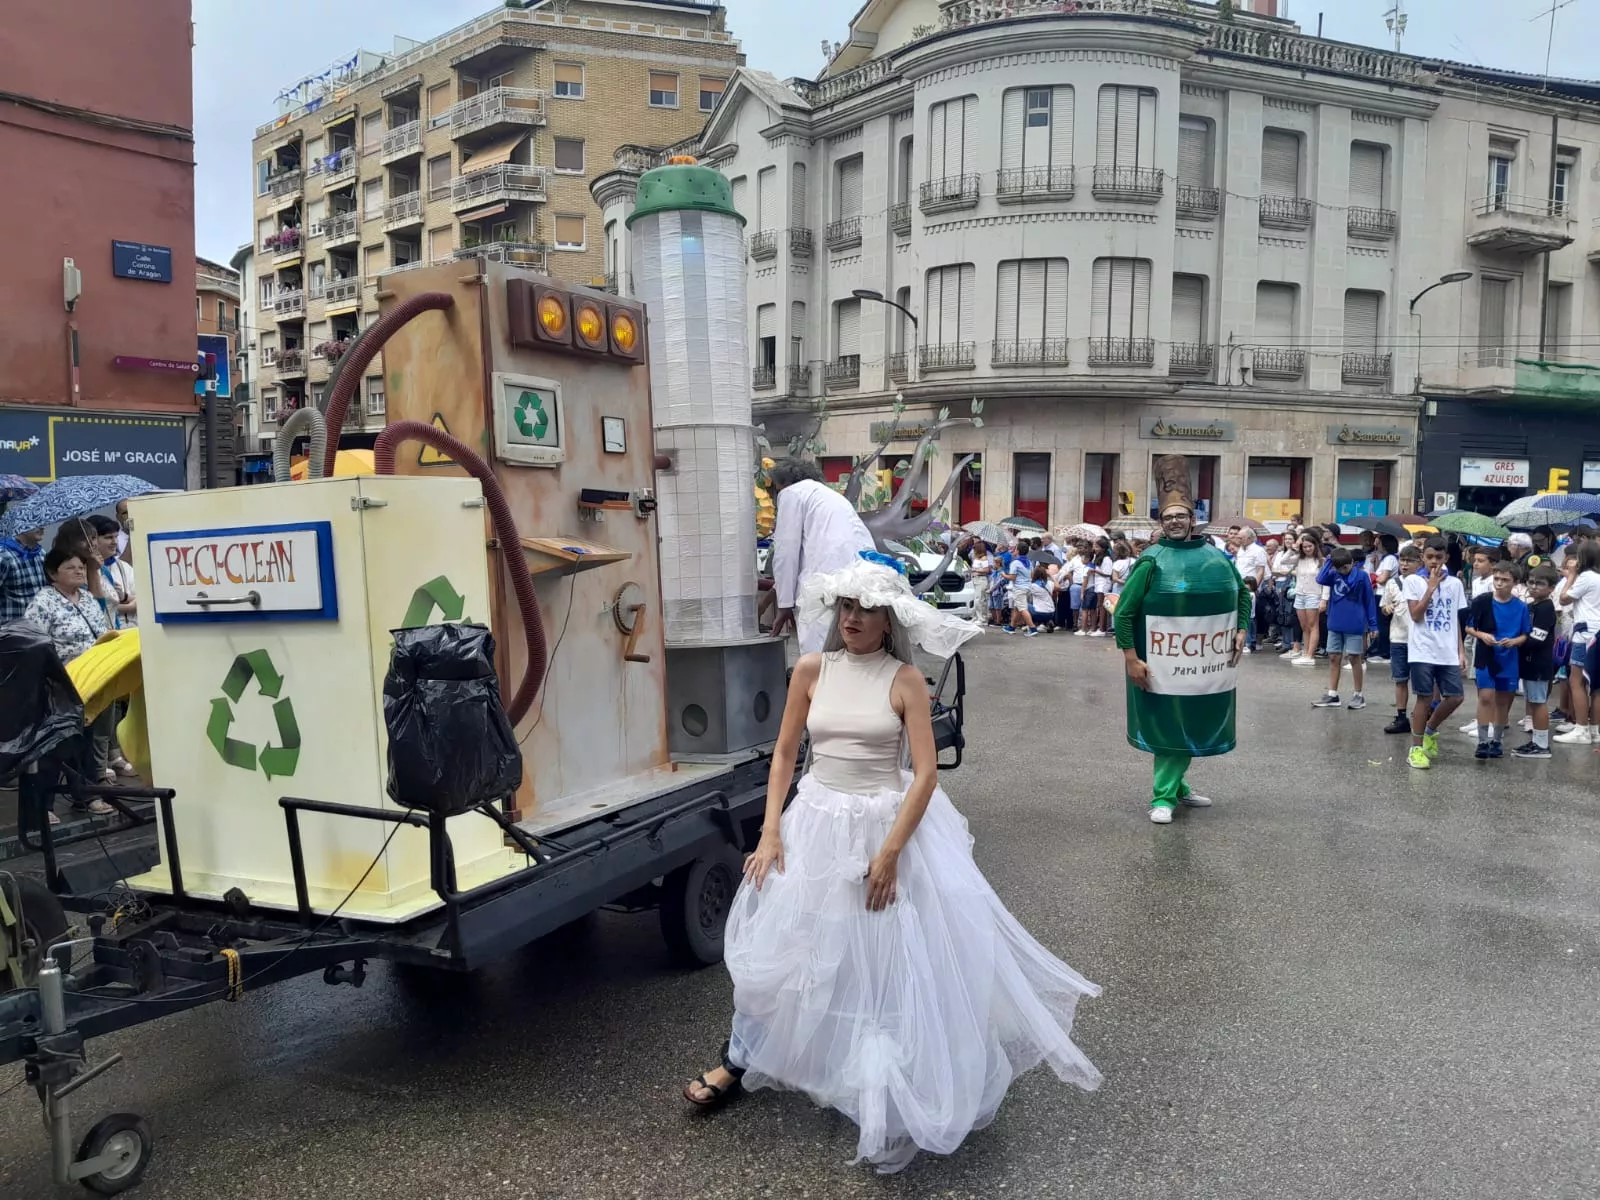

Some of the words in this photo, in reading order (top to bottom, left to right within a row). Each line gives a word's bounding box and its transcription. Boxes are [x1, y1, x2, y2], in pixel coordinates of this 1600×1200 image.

[62, 448, 100, 462] JOSÉ
[124, 451, 178, 464] GRACIA
[1494, 461, 1515, 471] GRES
[1484, 474, 1524, 485] AZULEJOS
[165, 540, 296, 587] RECI-CLEAN
